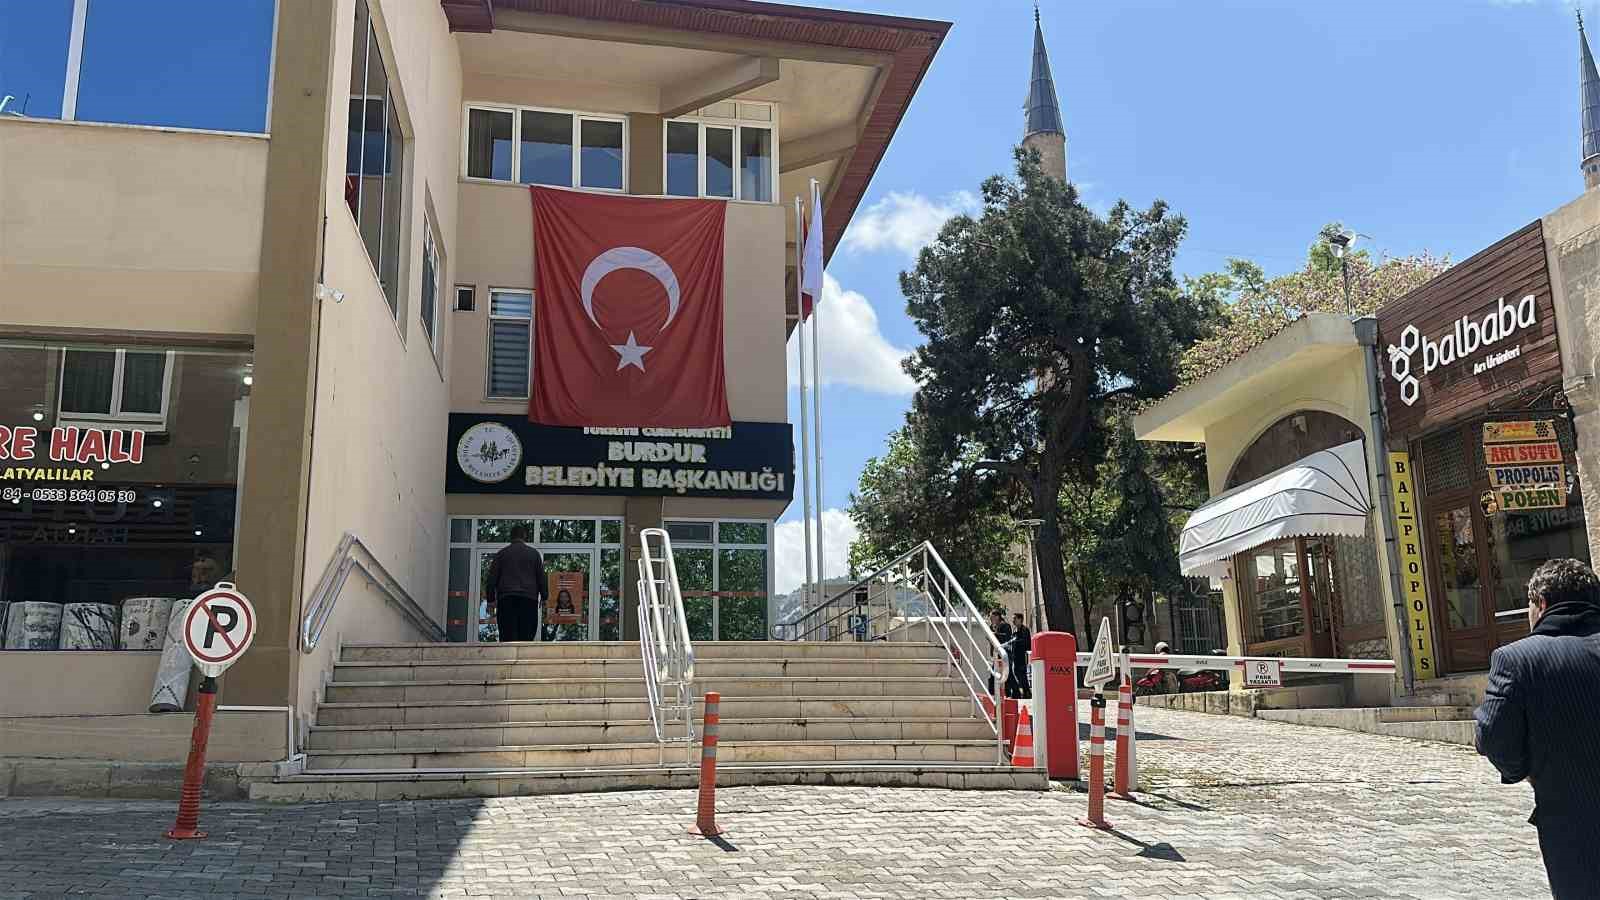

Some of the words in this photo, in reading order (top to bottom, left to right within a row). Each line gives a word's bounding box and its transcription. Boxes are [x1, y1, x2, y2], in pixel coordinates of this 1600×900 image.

[1422, 295, 1536, 375] balbaba
[50, 426, 145, 463] HALI
[607, 442, 707, 463] BURDUR
[525, 462, 634, 488] BELEDİYE
[641, 467, 786, 494] BAŞKANLIĞI
[3, 488, 21, 500] 84
[32, 489, 67, 501] 0533
[69, 490, 95, 502] 364
[97, 490, 116, 502] 05
[118, 491, 136, 503] 30
[1502, 489, 1561, 508] POLEN
